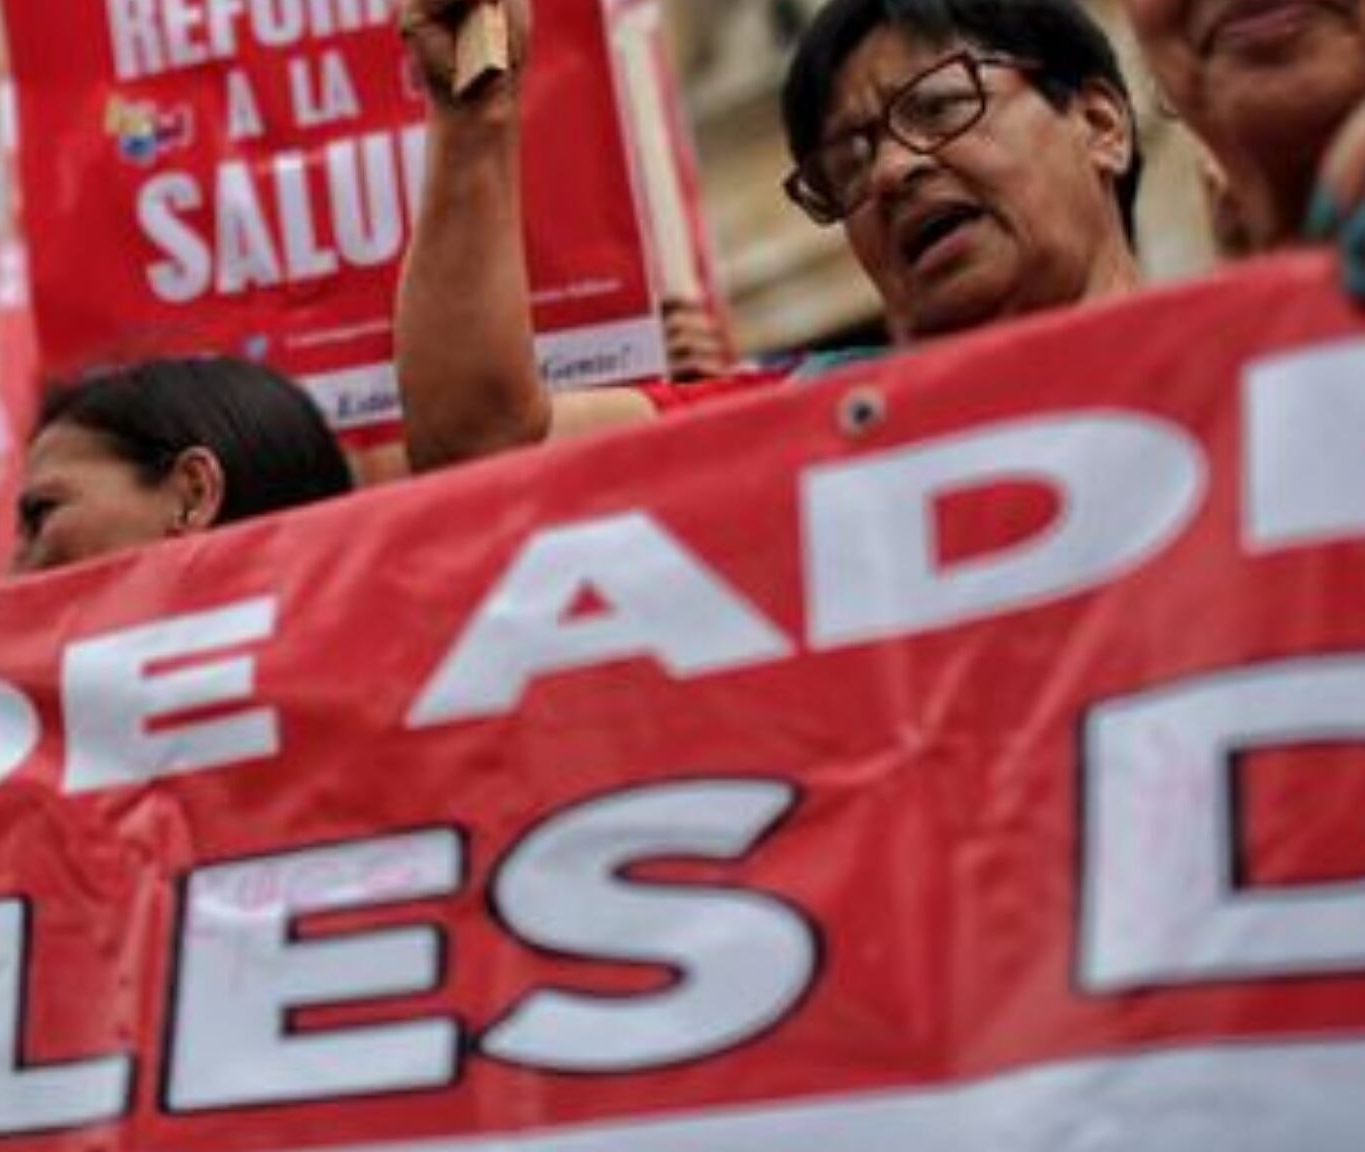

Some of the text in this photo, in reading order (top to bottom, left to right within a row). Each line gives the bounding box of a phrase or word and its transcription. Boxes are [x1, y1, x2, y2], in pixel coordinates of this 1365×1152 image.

[225, 49, 358, 139] A LA
[136, 122, 427, 304] SALU
[405, 334, 1365, 730] AD
